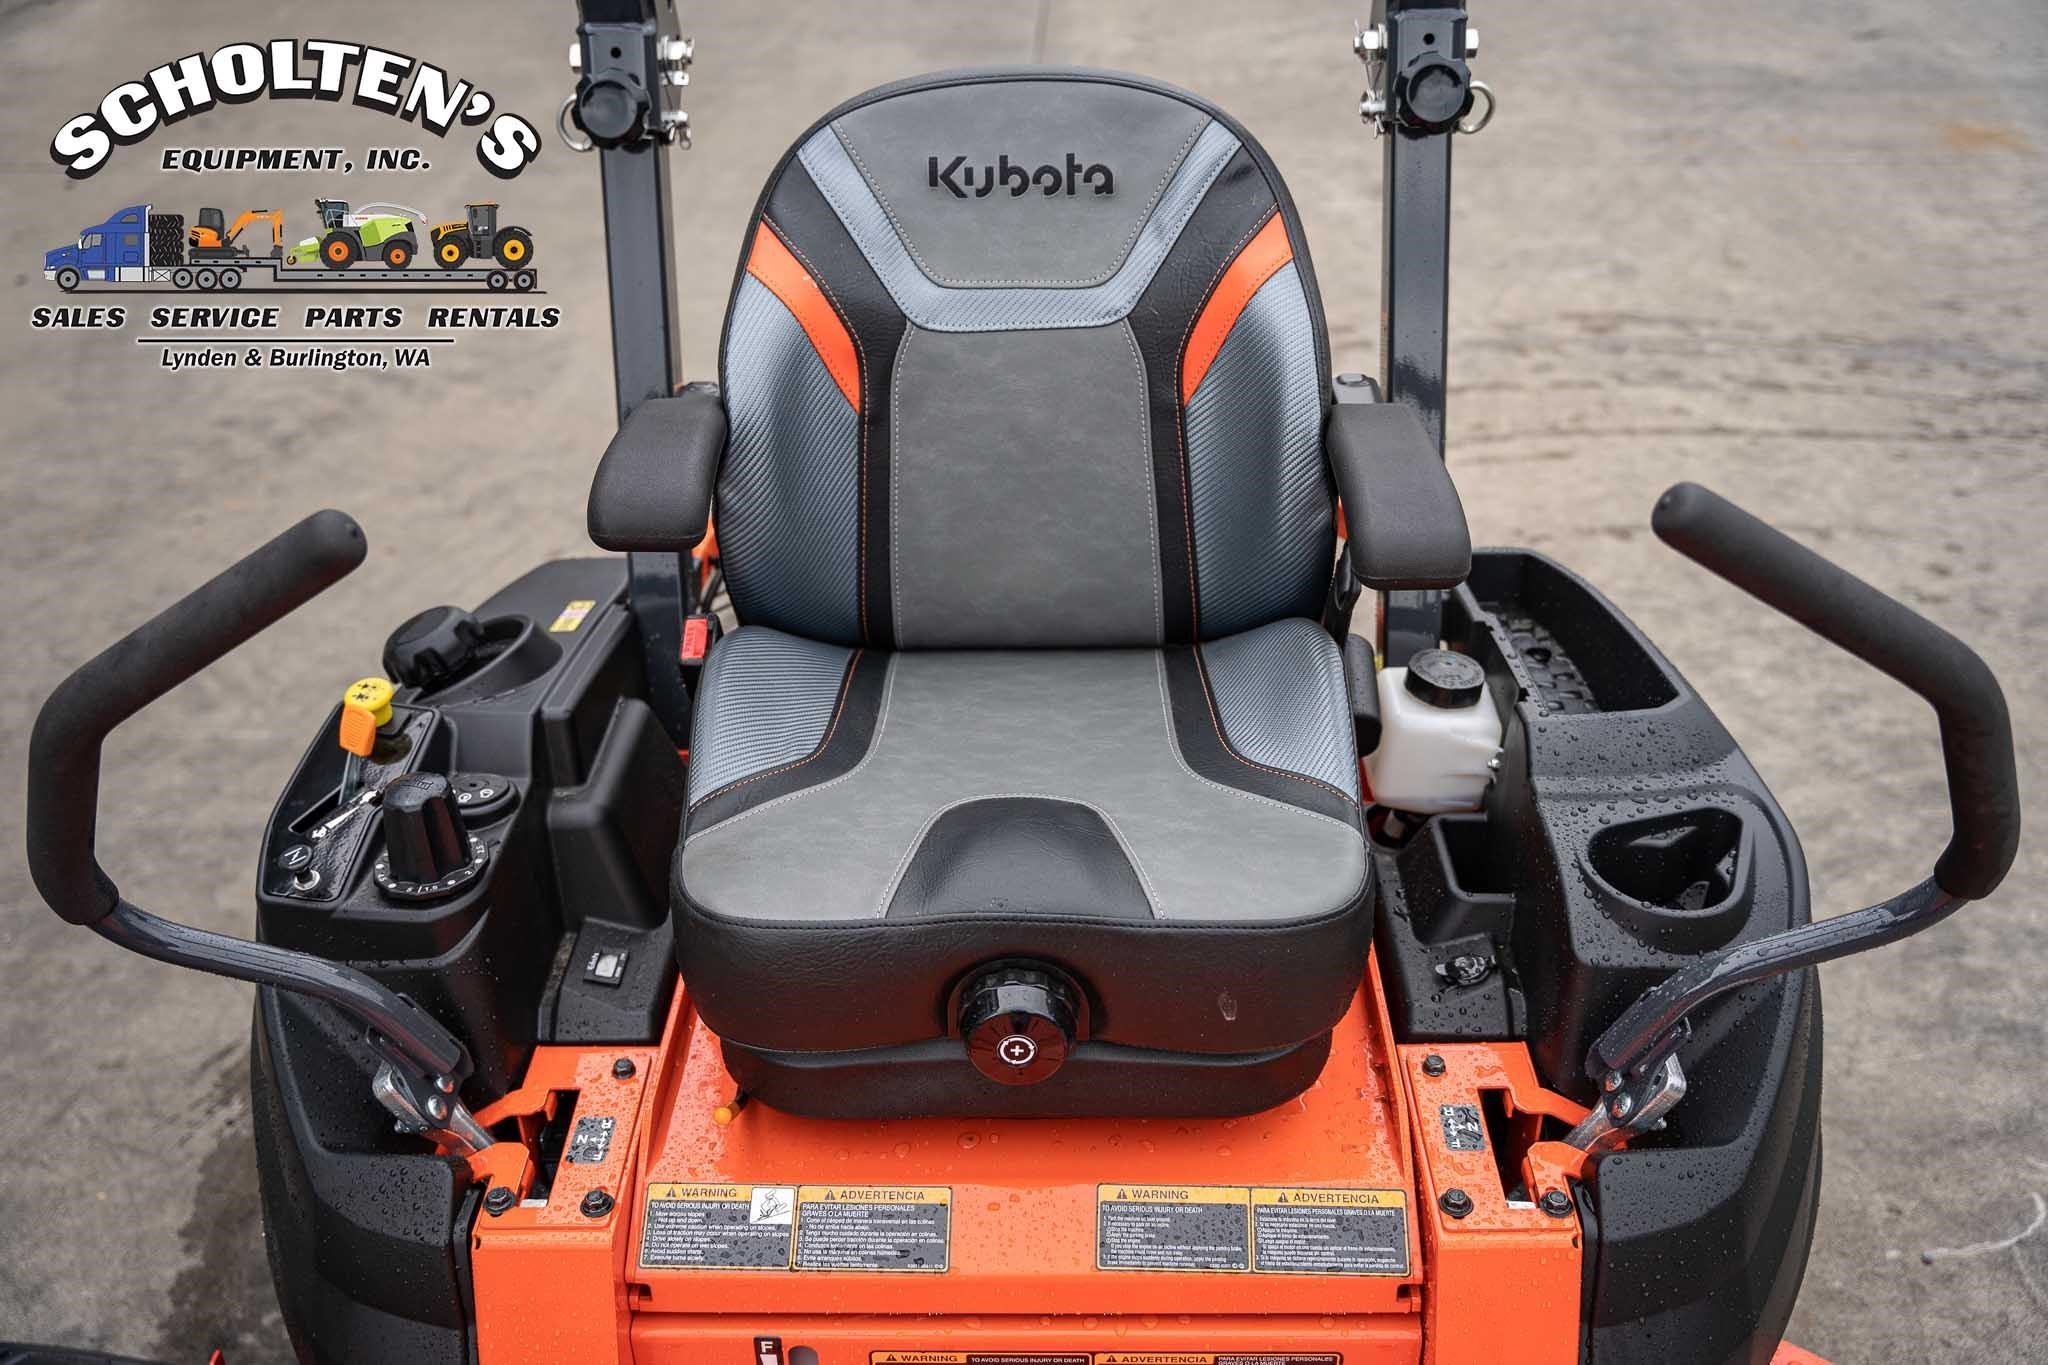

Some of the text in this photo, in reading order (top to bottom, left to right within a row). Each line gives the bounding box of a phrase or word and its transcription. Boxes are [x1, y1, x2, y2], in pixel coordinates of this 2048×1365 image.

[928, 152, 1114, 199] Kubota
[682, 1188, 737, 1198] WARNING
[840, 1190, 925, 1200] ADVERTENCIA
[1132, 1190, 1189, 1200] WARNING
[1292, 1193, 1380, 1204] ADVERTENCIA
[760, 1341, 773, 1353] F
[901, 1354, 958, 1363] WARNING
[1121, 1356, 1208, 1364] ADVERTENCIA
